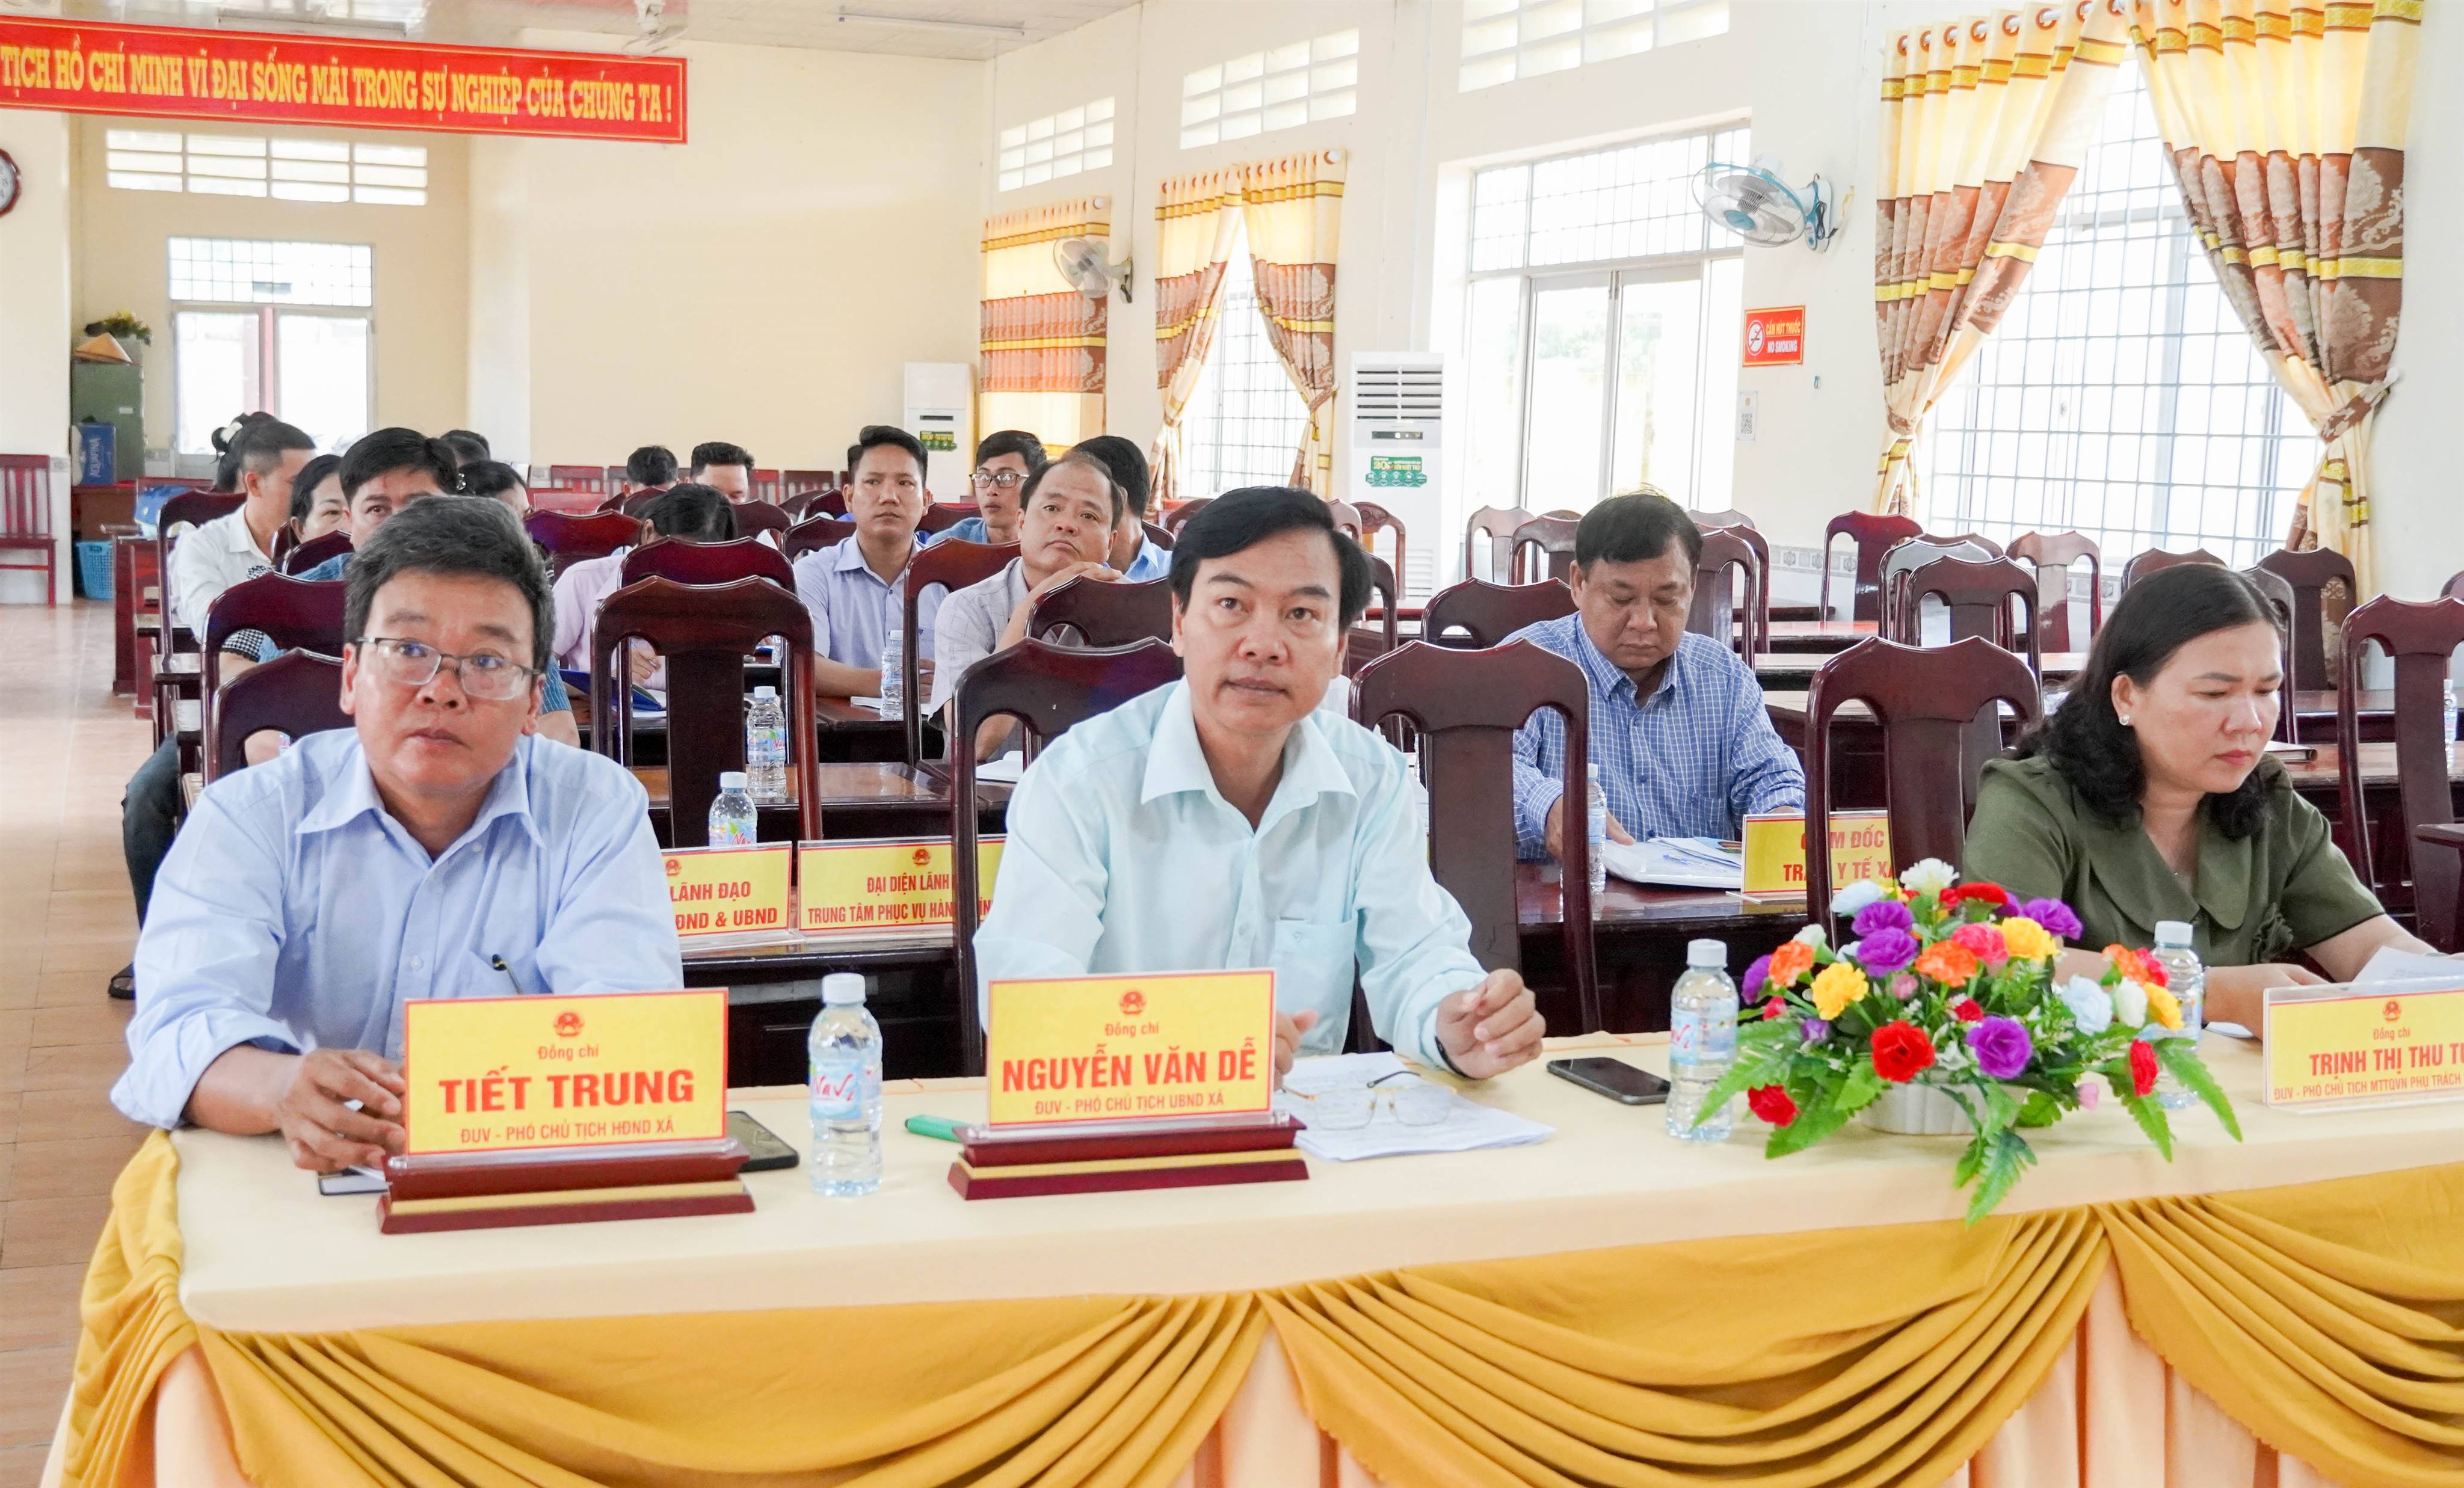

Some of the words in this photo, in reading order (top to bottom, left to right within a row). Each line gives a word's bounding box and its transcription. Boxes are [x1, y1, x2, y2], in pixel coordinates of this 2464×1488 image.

[1, 46, 51, 97] TỊCH
[55, 34, 84, 90] HỒ
[89, 41, 126, 93] CHÍ
[130, 54, 184, 97] MINH
[212, 60, 248, 110] ĐẠI
[252, 47, 307, 103] SỐNG
[312, 57, 350, 106] MÃI
[353, 67, 417, 110] TRONG
[422, 65, 448, 121] SỰ
[452, 66, 522, 124] NGHIỆP
[526, 66, 565, 117] CỦA
[570, 70, 635, 120] CHÚNG
[639, 83, 663, 123] TA
[1767, 340, 1775, 354] NO
[1775, 340, 1797, 353] SMOKING
[1850, 824, 1884, 849] ĐỐC
[1837, 862, 1847, 879] Y
[1852, 856, 1872, 880] TẾ
[670, 882, 712, 902] LÃNH
[718, 881, 751, 902] ĐẠO
[867, 876, 886, 896] ĐẠI
[890, 872, 916, 895] DIỆN
[920, 871, 949, 891] LÃNH
[715, 912, 727, 927] &
[733, 908, 777, 926] UBND
[808, 906, 846, 924] TRUNG
[849, 902, 875, 923] TÂM
[878, 904, 908, 925] PHỤC
[912, 903, 926, 923] VỤ
[1002, 1044, 1132, 1092] NGUYỄN
[1144, 1046, 1206, 1084] VĂN
[1218, 1037, 1257, 1081] DỄ
[2309, 1051, 2367, 1079] TRỊNH
[2373, 1048, 2401, 1075] THỊ
[2408, 1044, 2443, 1068] THU
[439, 1065, 532, 1113] TIẾT
[547, 1069, 694, 1108] TRUNG
[2274, 1087, 2293, 1101] ĐUV
[2370, 1077, 2407, 1091] MTTQVN
[1035, 1099, 1062, 1115] ĐUV
[1169, 1093, 1203, 1108] UBND
[460, 1128, 491, 1143] ĐUV
[574, 1122, 607, 1140] TỊCH
[612, 1120, 651, 1137] HĐND
